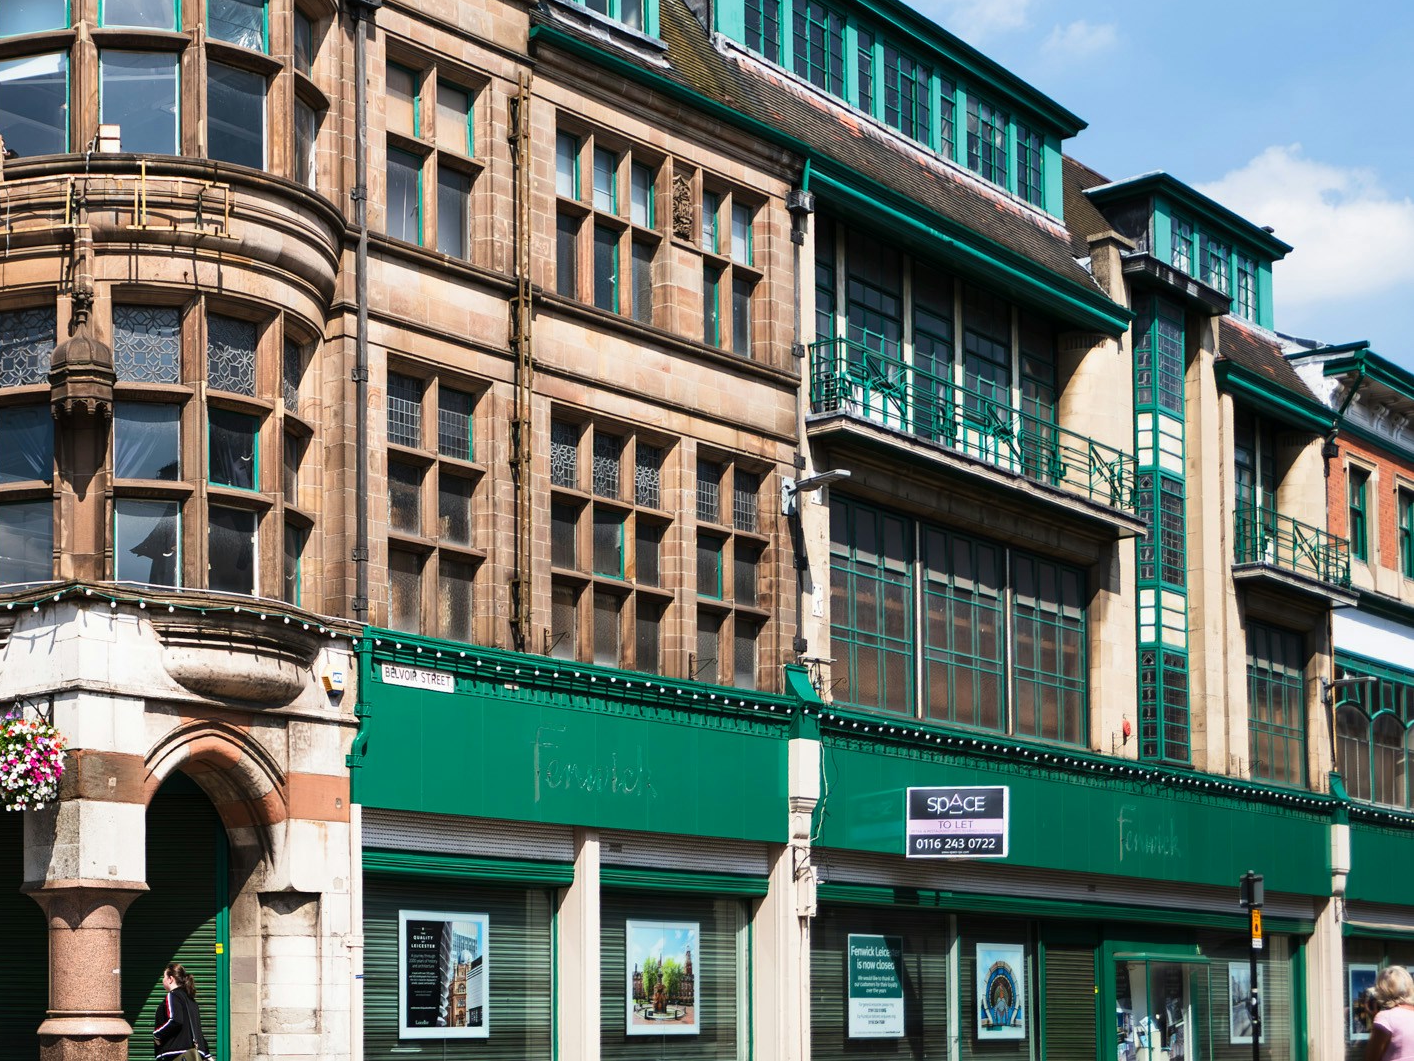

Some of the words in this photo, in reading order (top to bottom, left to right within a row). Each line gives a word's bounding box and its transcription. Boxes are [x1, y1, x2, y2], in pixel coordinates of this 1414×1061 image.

[385, 666, 418, 682] BELVOIR
[420, 671, 451, 687] STREET
[938, 820, 952, 829] TO
[955, 820, 974, 829] LET
[916, 838, 942, 849] 0116
[944, 838, 965, 849] 243
[968, 837, 996, 849] 0722
[850, 945, 875, 957] Fenwick
[857, 959, 862, 970] is
[863, 961, 876, 970] now
